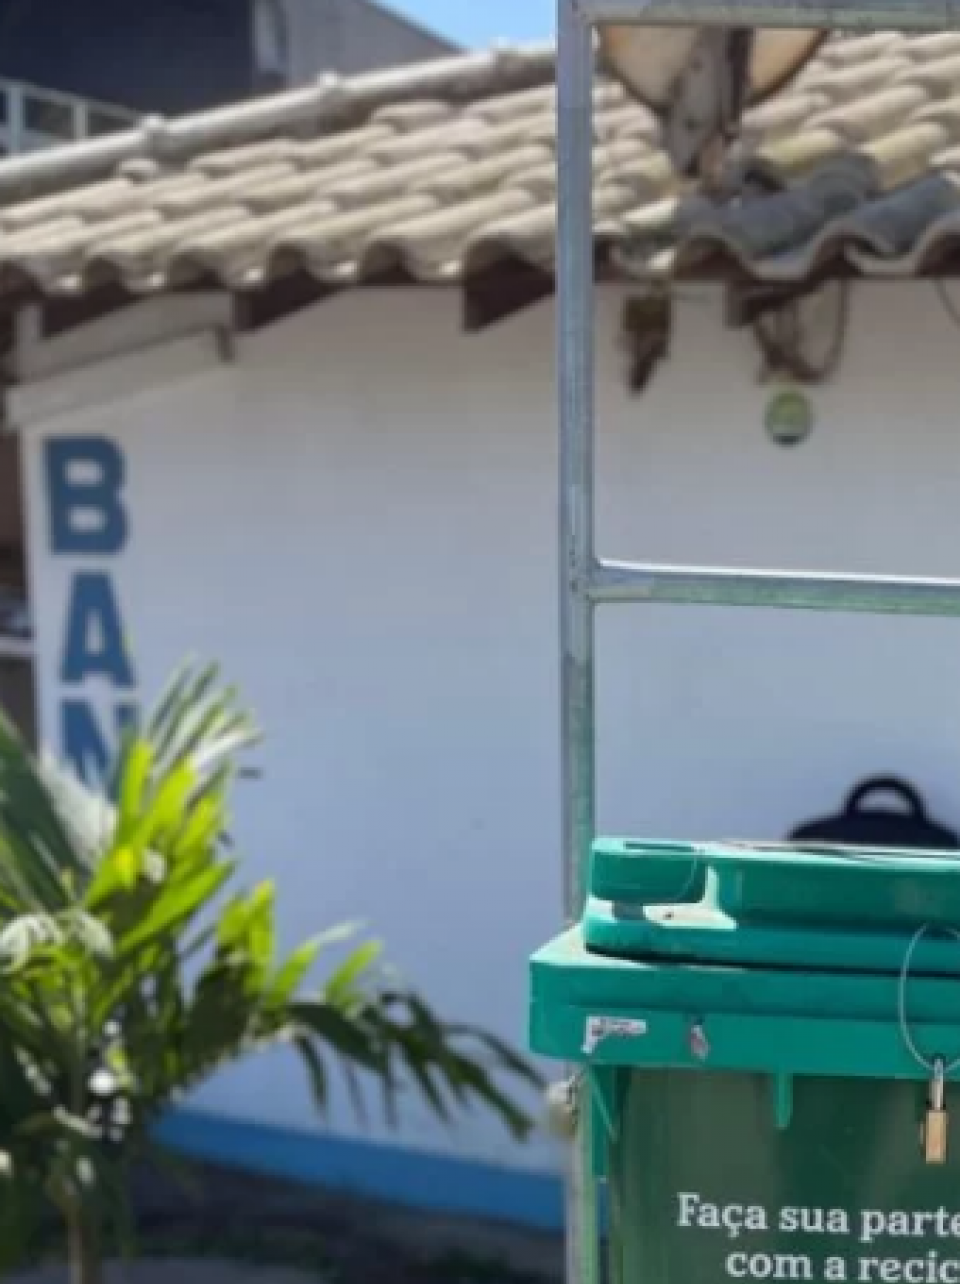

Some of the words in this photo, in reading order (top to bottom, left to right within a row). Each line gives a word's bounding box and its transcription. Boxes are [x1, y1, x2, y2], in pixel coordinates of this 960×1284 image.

[677, 1192, 768, 1238] Faça
[779, 1203, 849, 1235] sua
[725, 1250, 812, 1280] com
[823, 1254, 847, 1281] a
